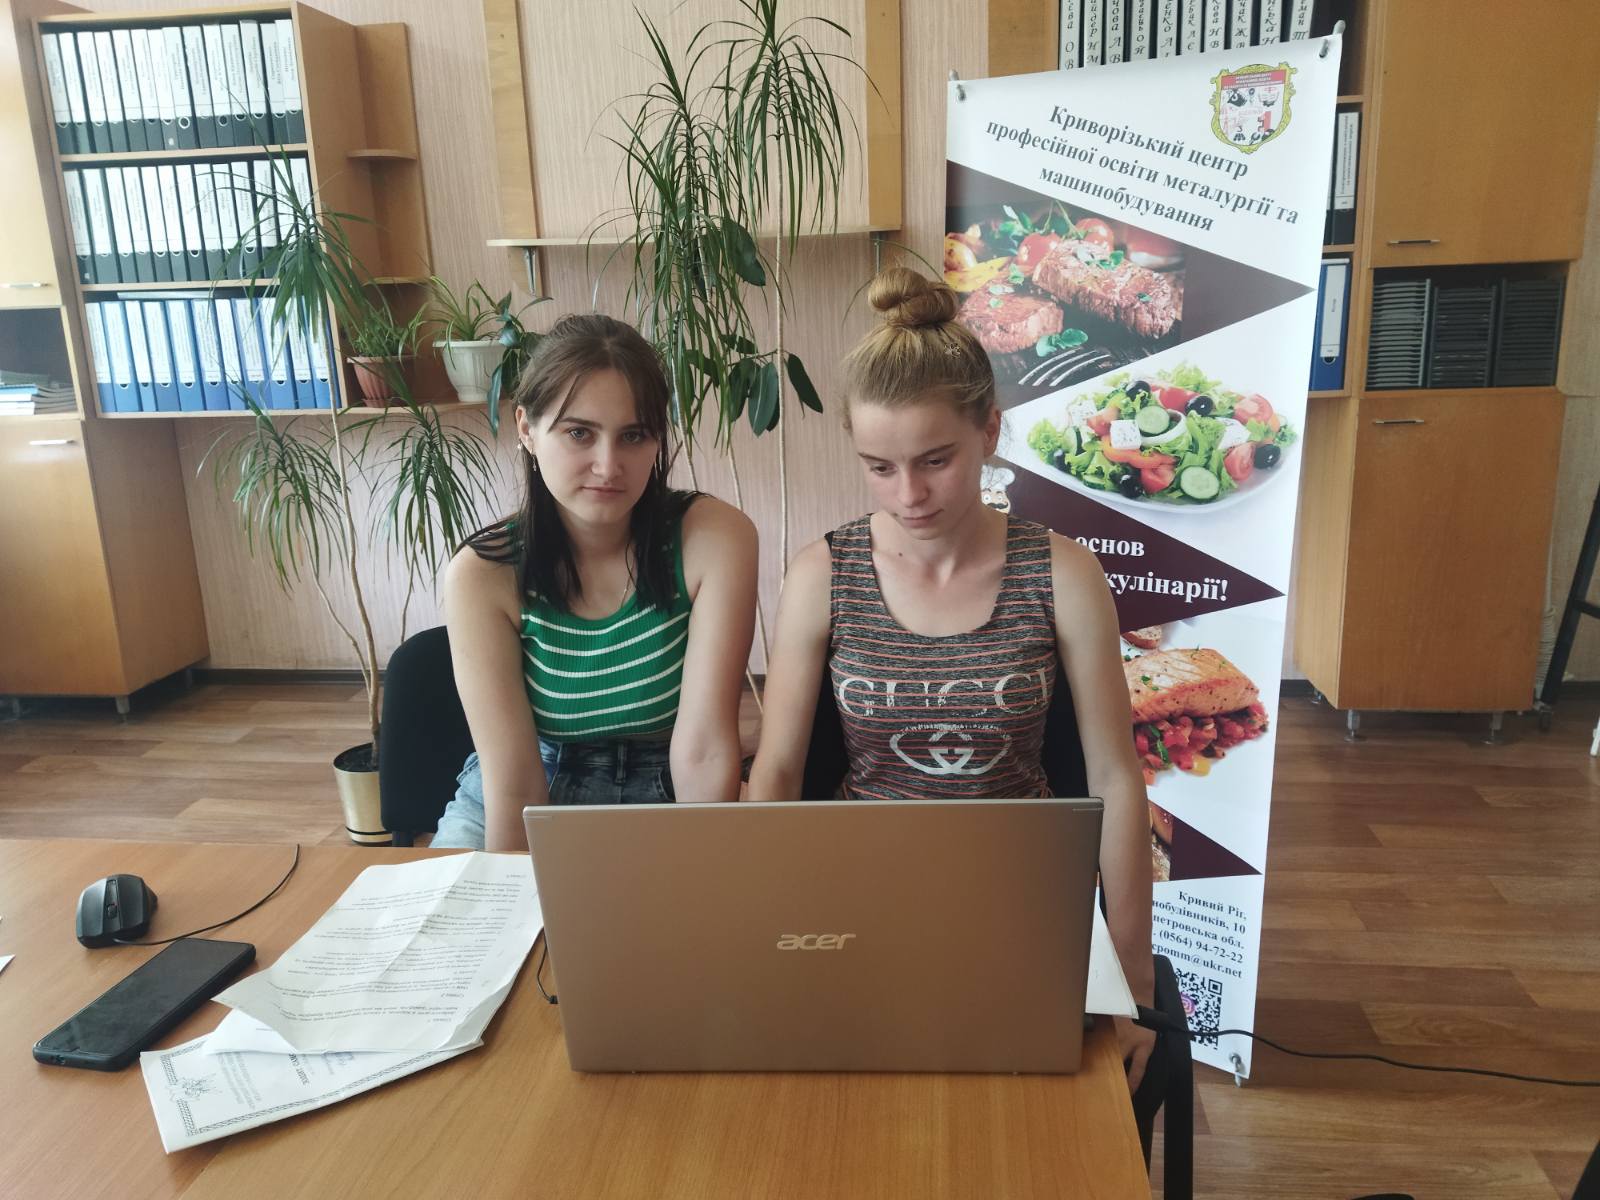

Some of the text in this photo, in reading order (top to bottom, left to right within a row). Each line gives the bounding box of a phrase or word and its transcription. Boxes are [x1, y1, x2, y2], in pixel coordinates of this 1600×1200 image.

[1049, 105, 1248, 180] Криворізький центр
[986, 122, 1299, 224] професійної освіти металургії та
[1039, 167, 1215, 231] машинобудування
[1179, 891, 1224, 912] Кривий
[776, 933, 856, 950] acer
[1234, 922, 1246, 934] 10
[1159, 930, 1243, 964] (0564) 94-72-22
[1221, 935, 1245, 949] обл.
